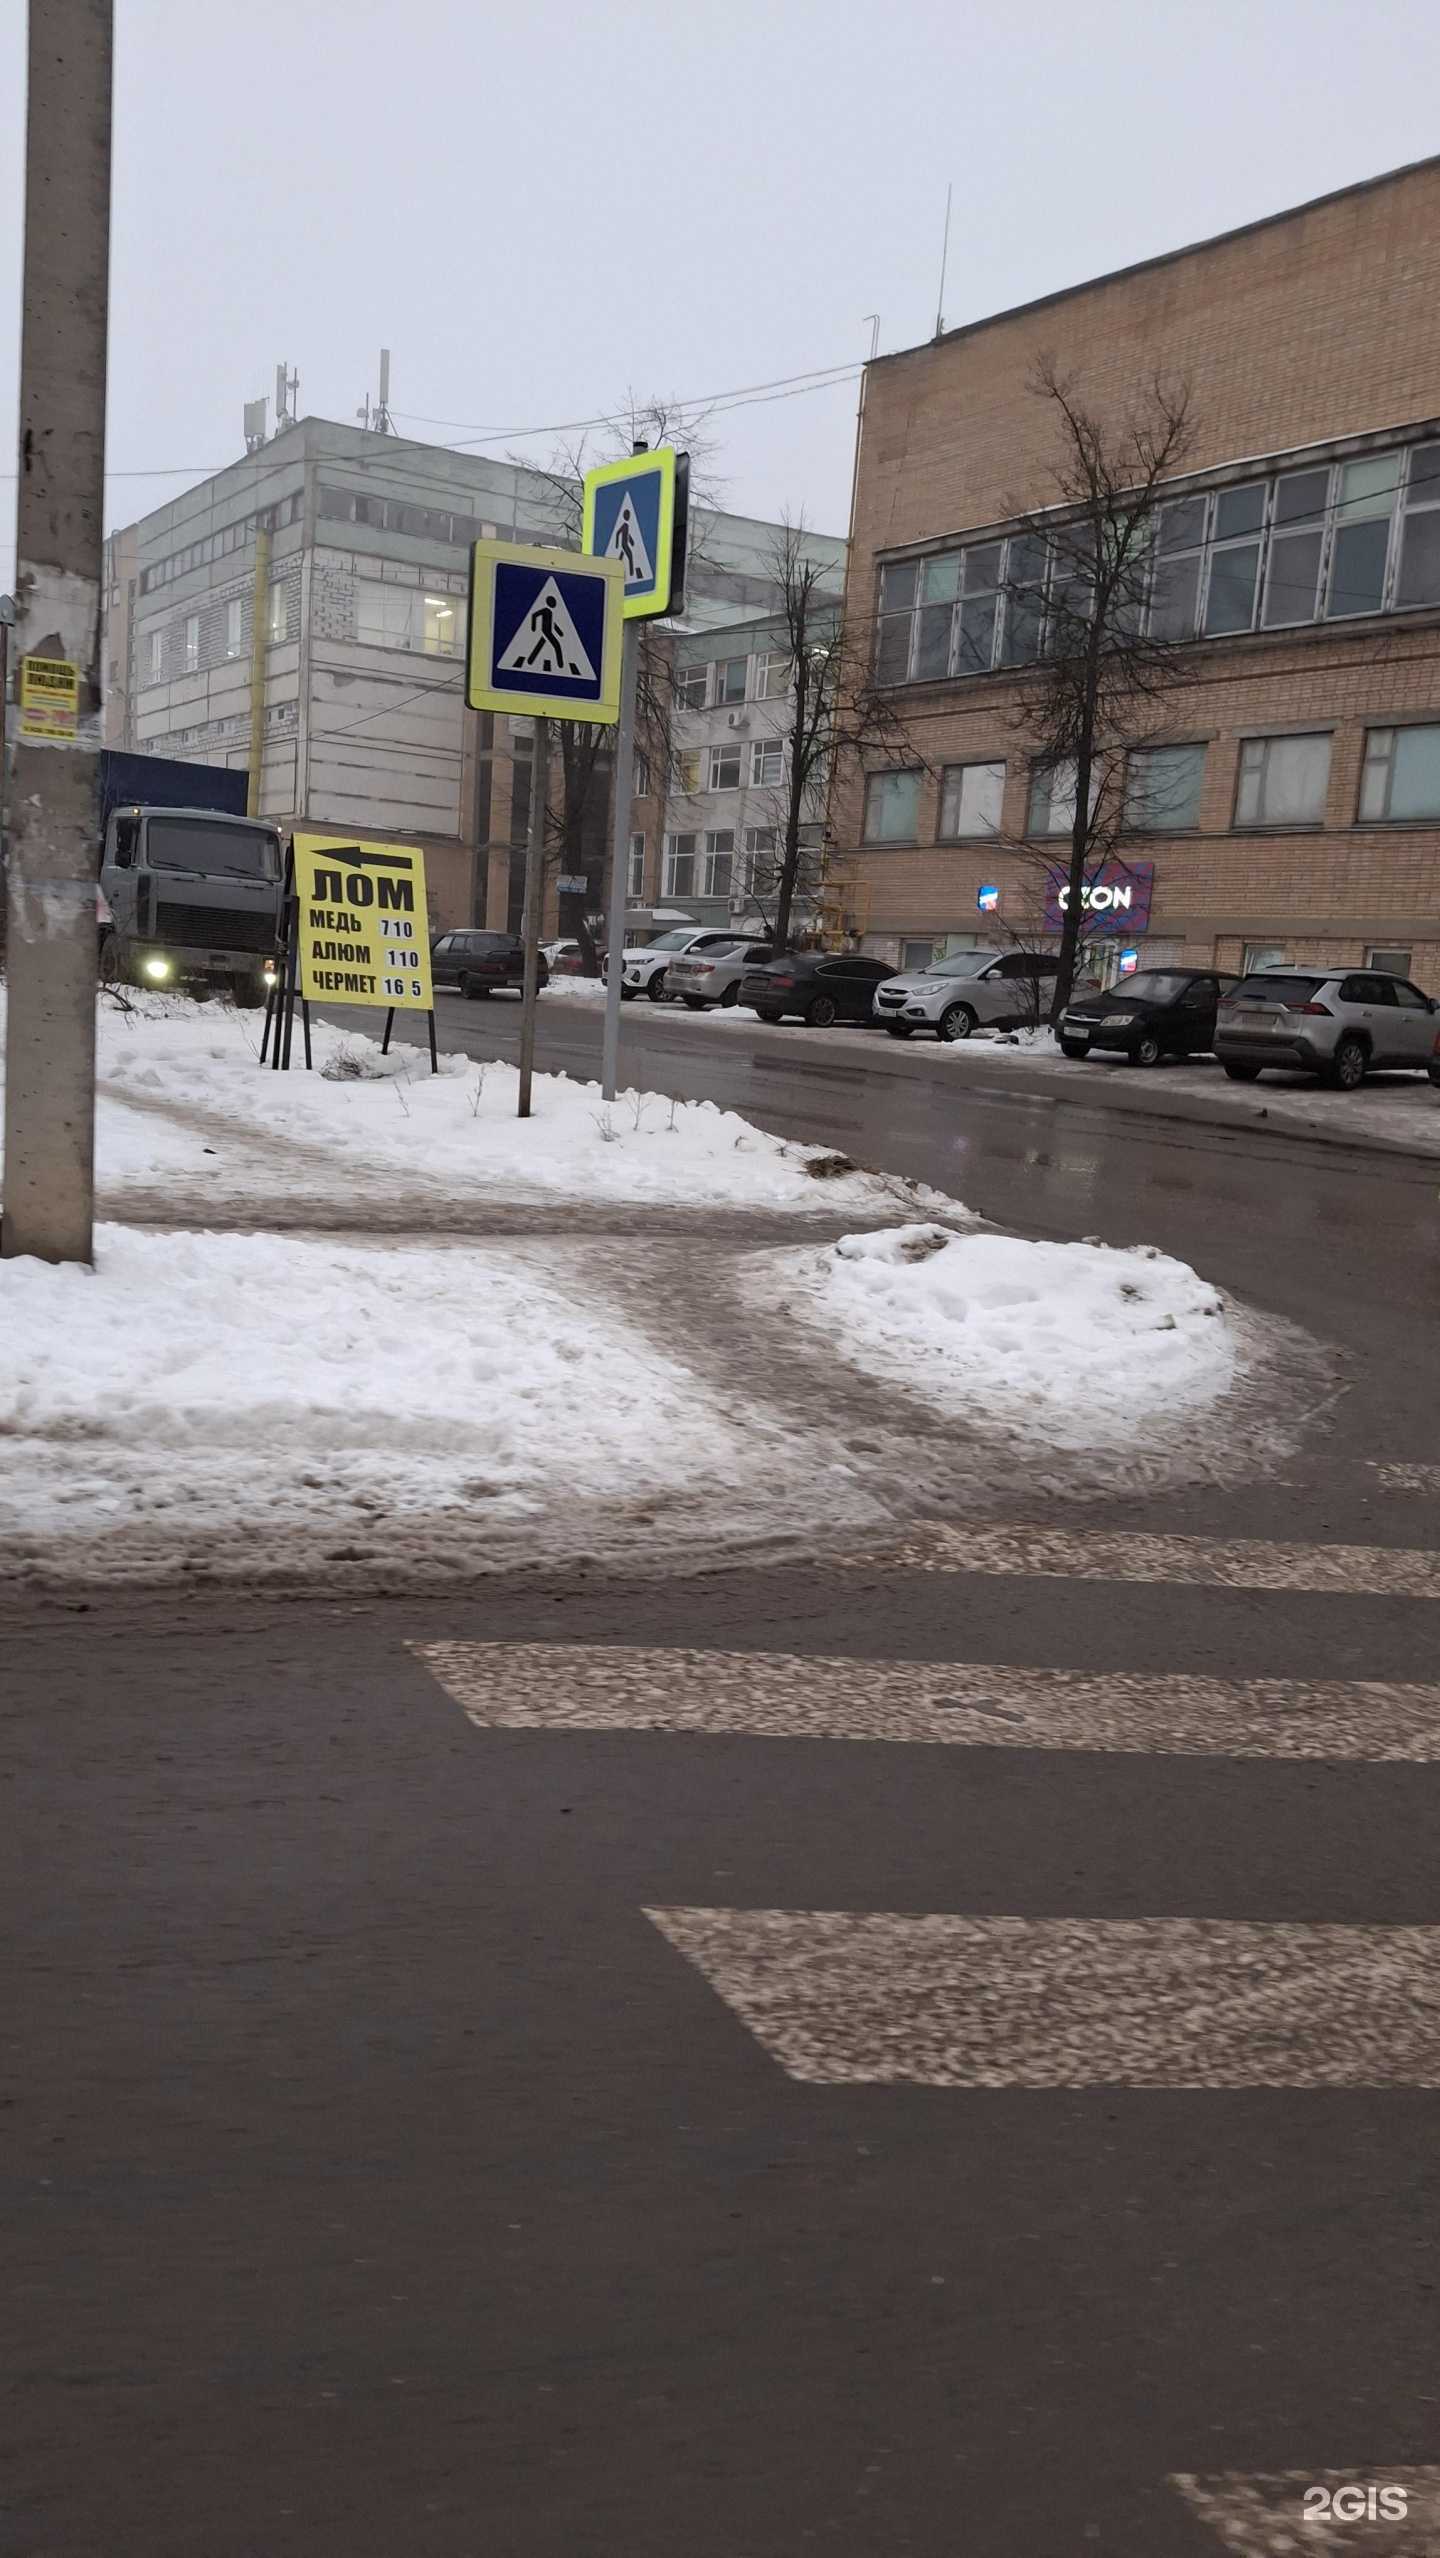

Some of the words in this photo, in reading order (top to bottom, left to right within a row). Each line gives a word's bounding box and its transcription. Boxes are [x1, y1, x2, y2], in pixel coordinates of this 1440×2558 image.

[312, 869, 414, 912] ЛОМ
[310, 909, 362, 934] МЕДЬ
[381, 920, 413, 938] 710
[312, 941, 371, 964] АЛЮМ
[388, 950, 419, 968] 110
[312, 970, 377, 994] ЧЕРМЕТ
